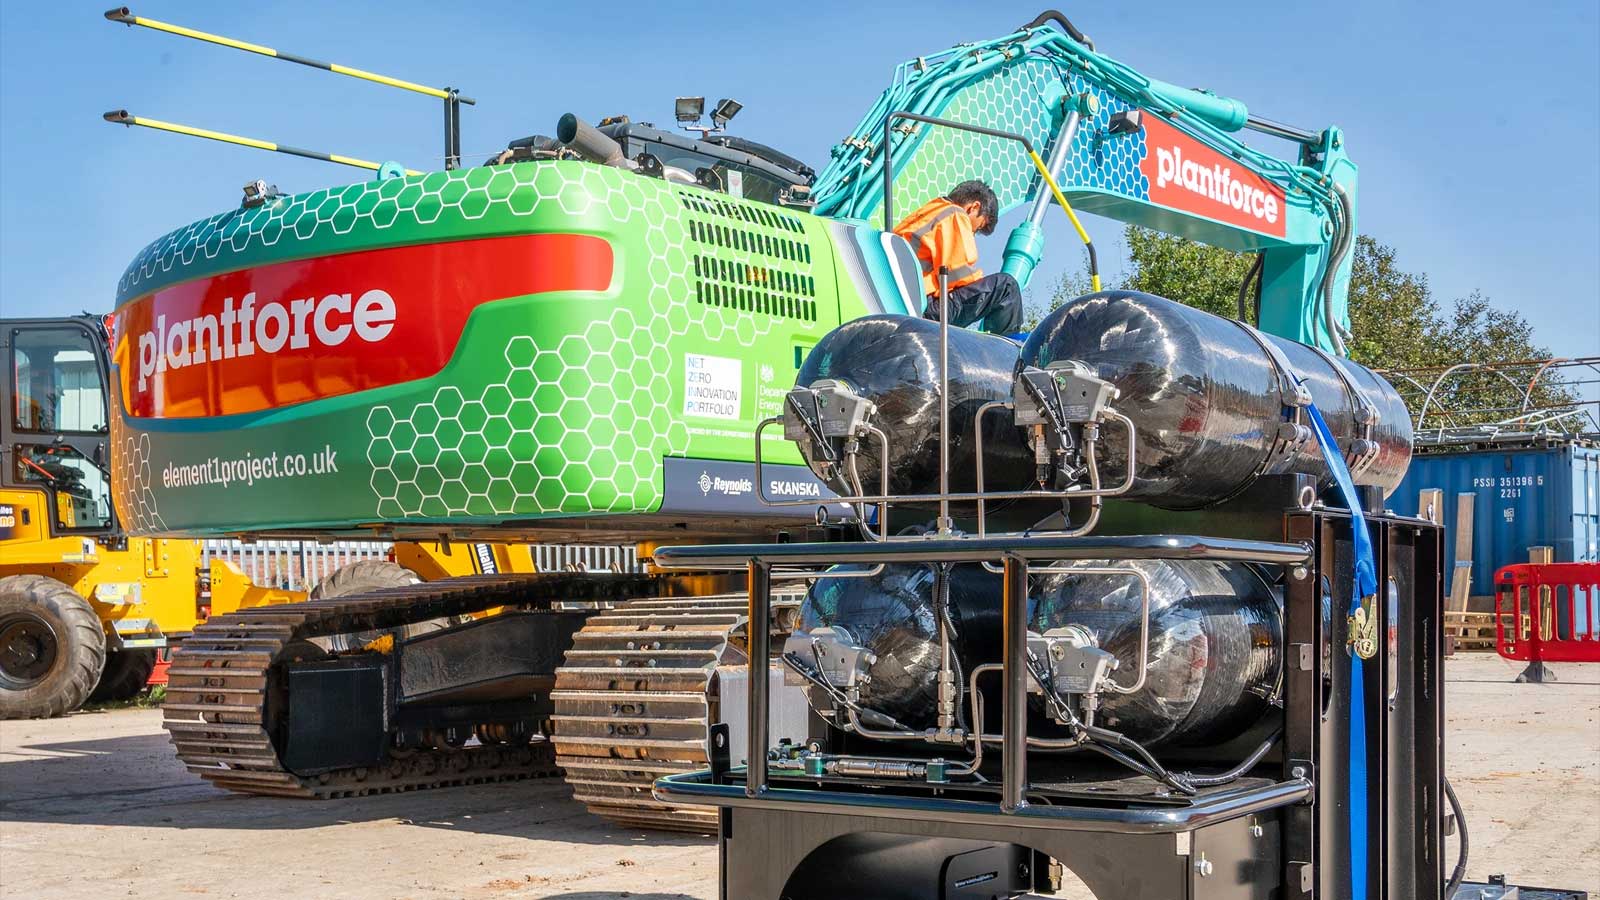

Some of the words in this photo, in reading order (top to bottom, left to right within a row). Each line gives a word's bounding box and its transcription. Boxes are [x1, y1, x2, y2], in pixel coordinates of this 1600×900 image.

[1156, 145, 1279, 224] plantforce
[138, 289, 397, 393] plantforce
[688, 357, 705, 369] NET
[688, 371, 712, 384] ZERO
[688, 386, 738, 401] INNOVATION
[687, 401, 735, 416] PORTFOLIO
[162, 444, 339, 489] element1project.co.uk
[713, 476, 753, 494] Reynolds
[770, 480, 820, 496] SKANSKA
[1473, 477, 1495, 488] PSSU
